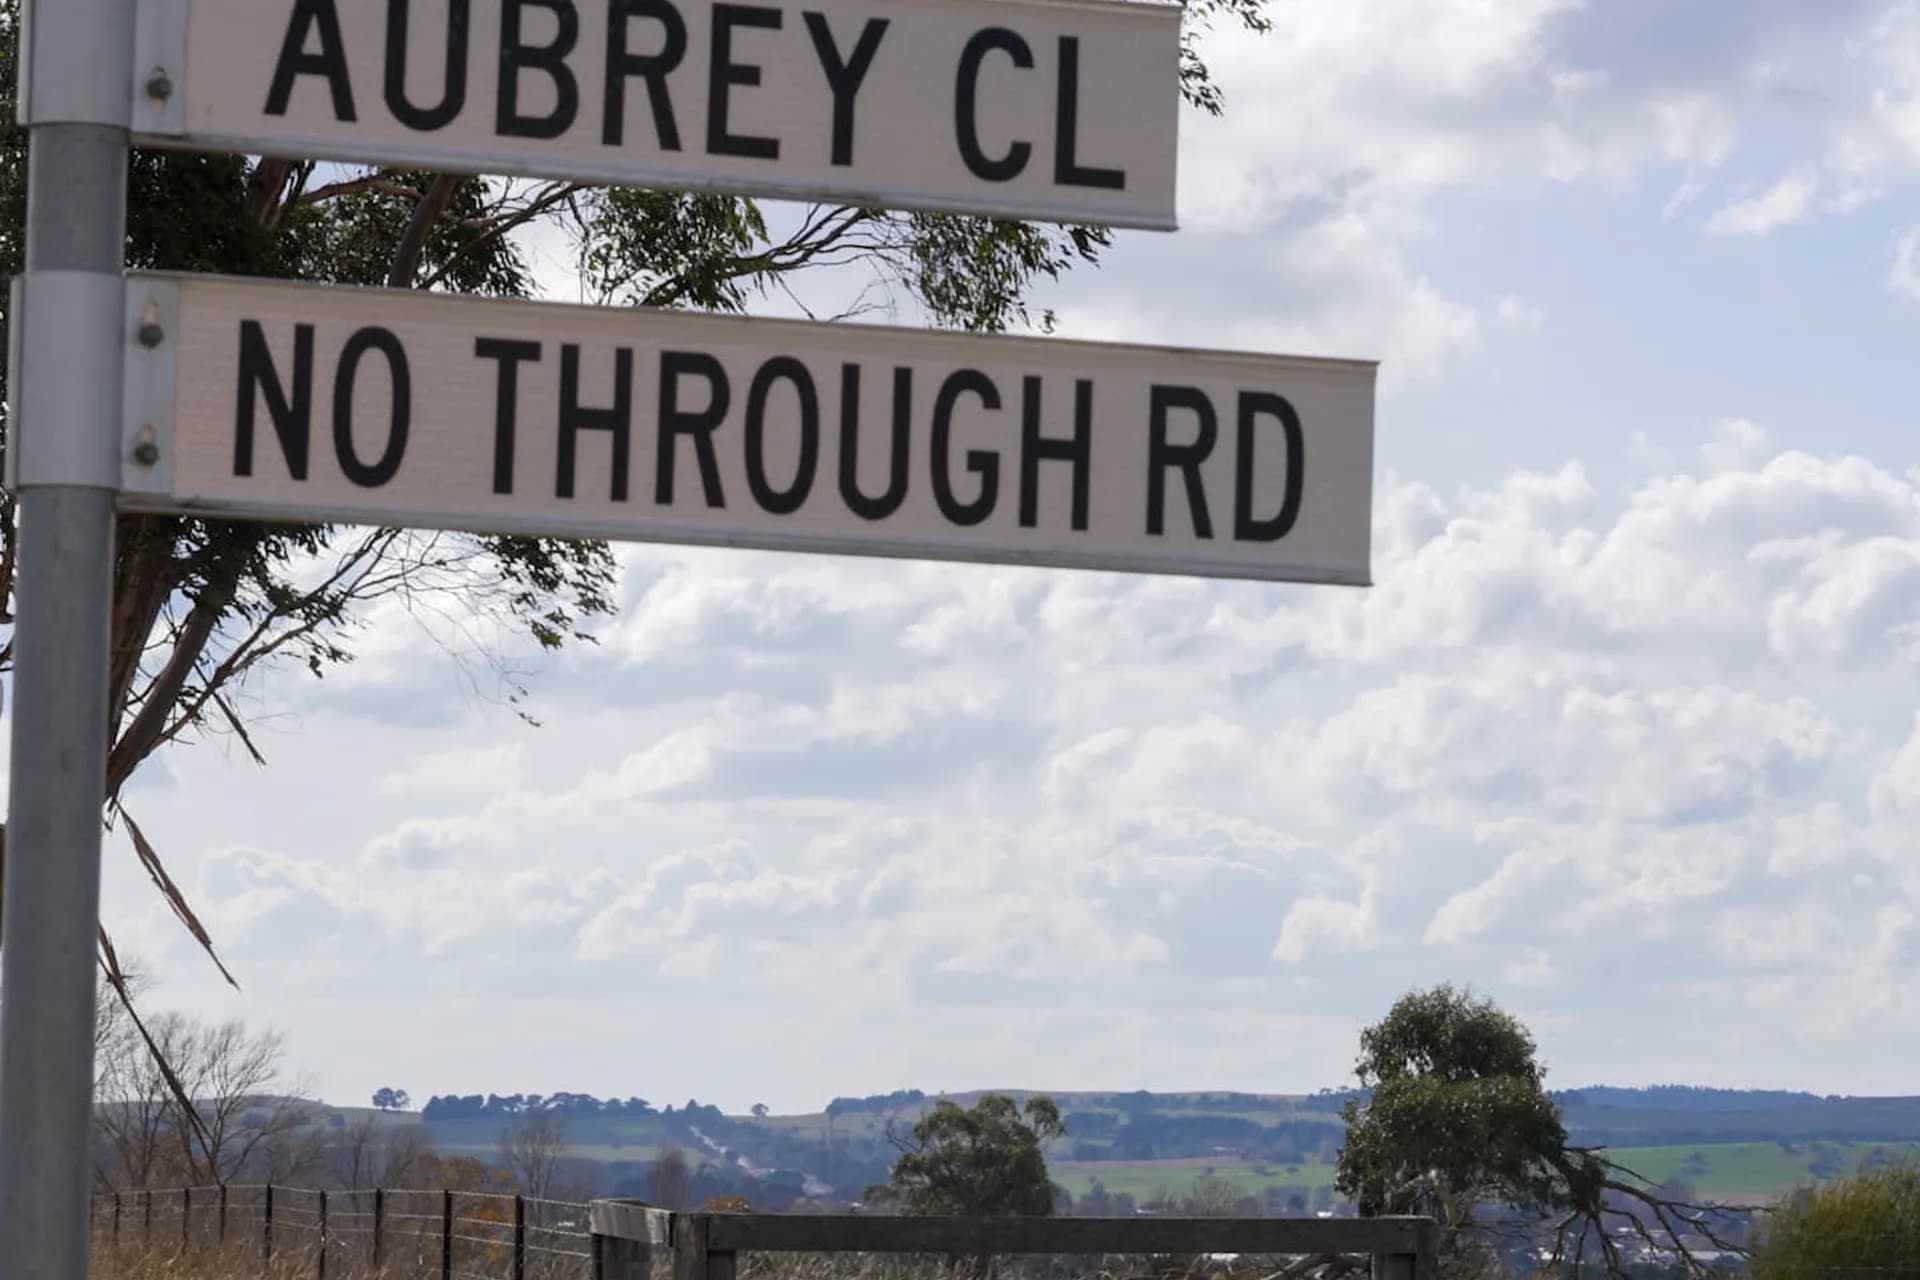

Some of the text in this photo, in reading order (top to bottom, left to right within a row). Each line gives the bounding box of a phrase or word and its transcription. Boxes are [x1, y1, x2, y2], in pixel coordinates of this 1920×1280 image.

[262, 0, 1126, 192] AUBREY CL
[232, 318, 1306, 544] NO THROUGH RD
